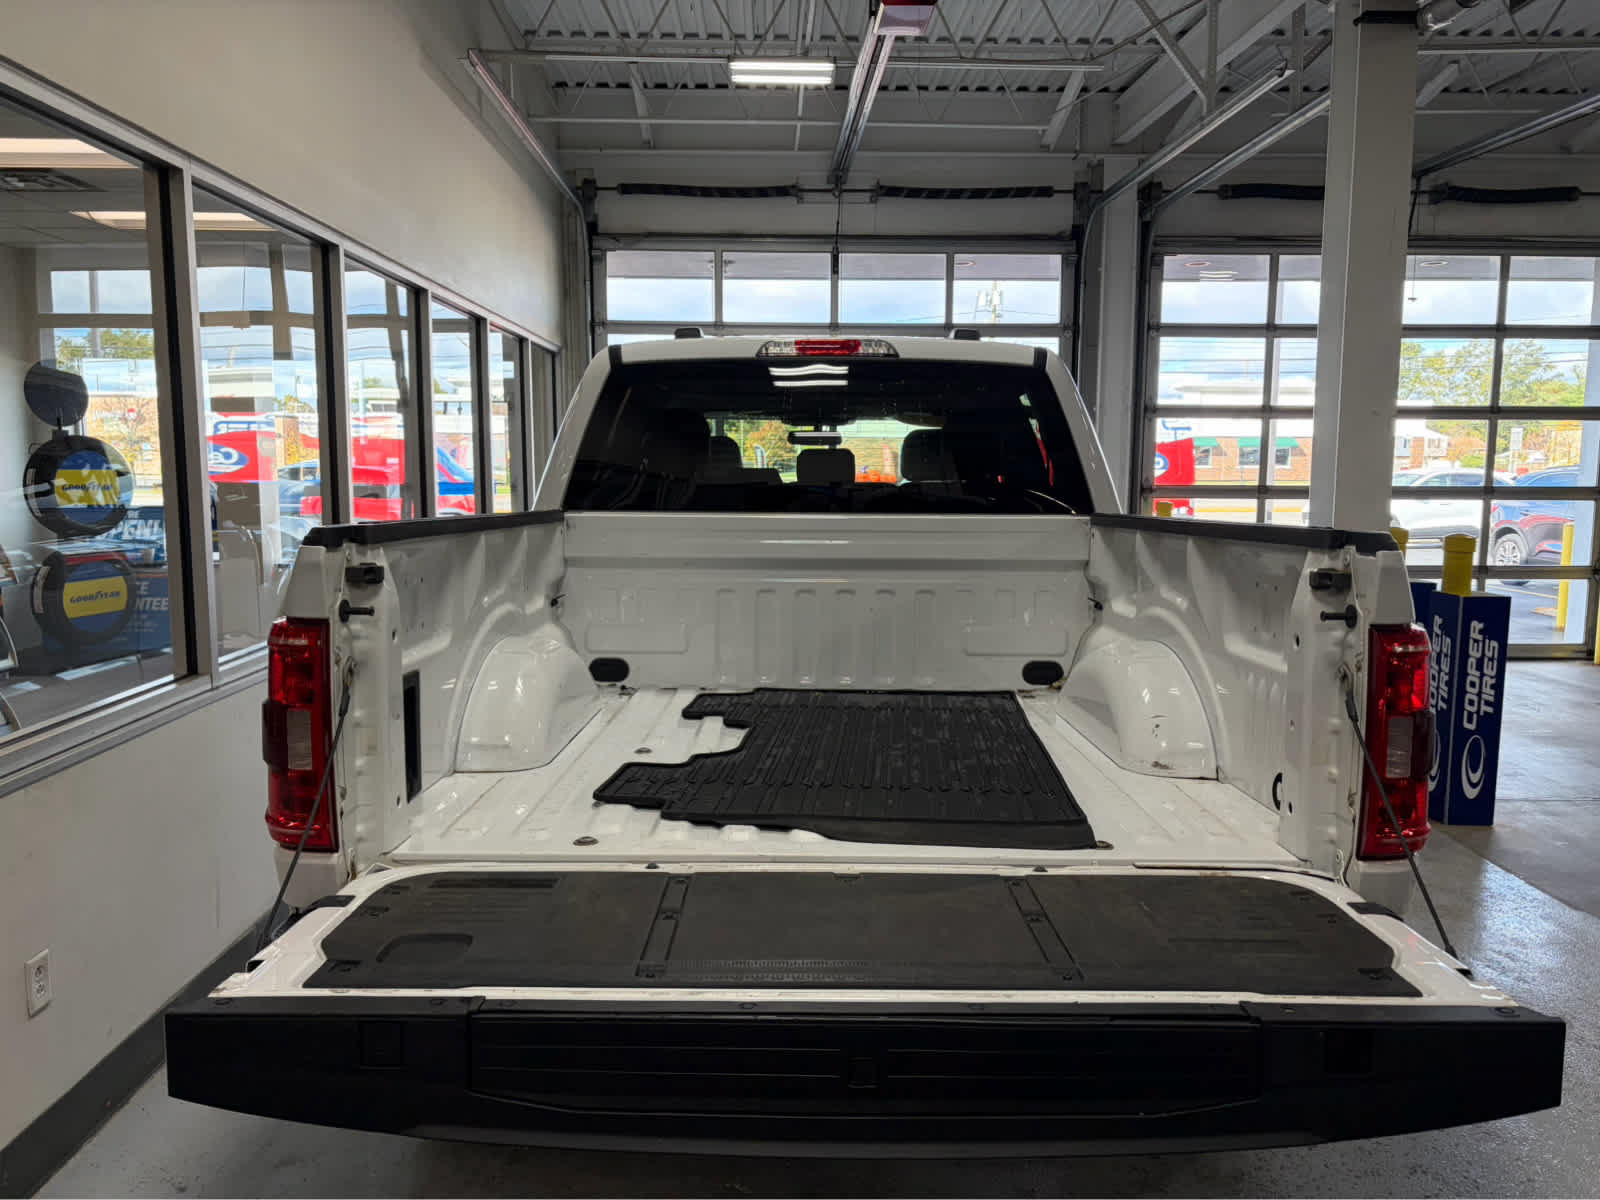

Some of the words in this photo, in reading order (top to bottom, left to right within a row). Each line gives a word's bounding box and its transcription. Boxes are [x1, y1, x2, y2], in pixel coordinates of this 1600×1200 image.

[70, 591, 121, 605] GOODYEAR
[1437, 633, 1452, 711] TIRES
[1463, 619, 1485, 731] COOPER
[1480, 638, 1499, 716] TIRES
